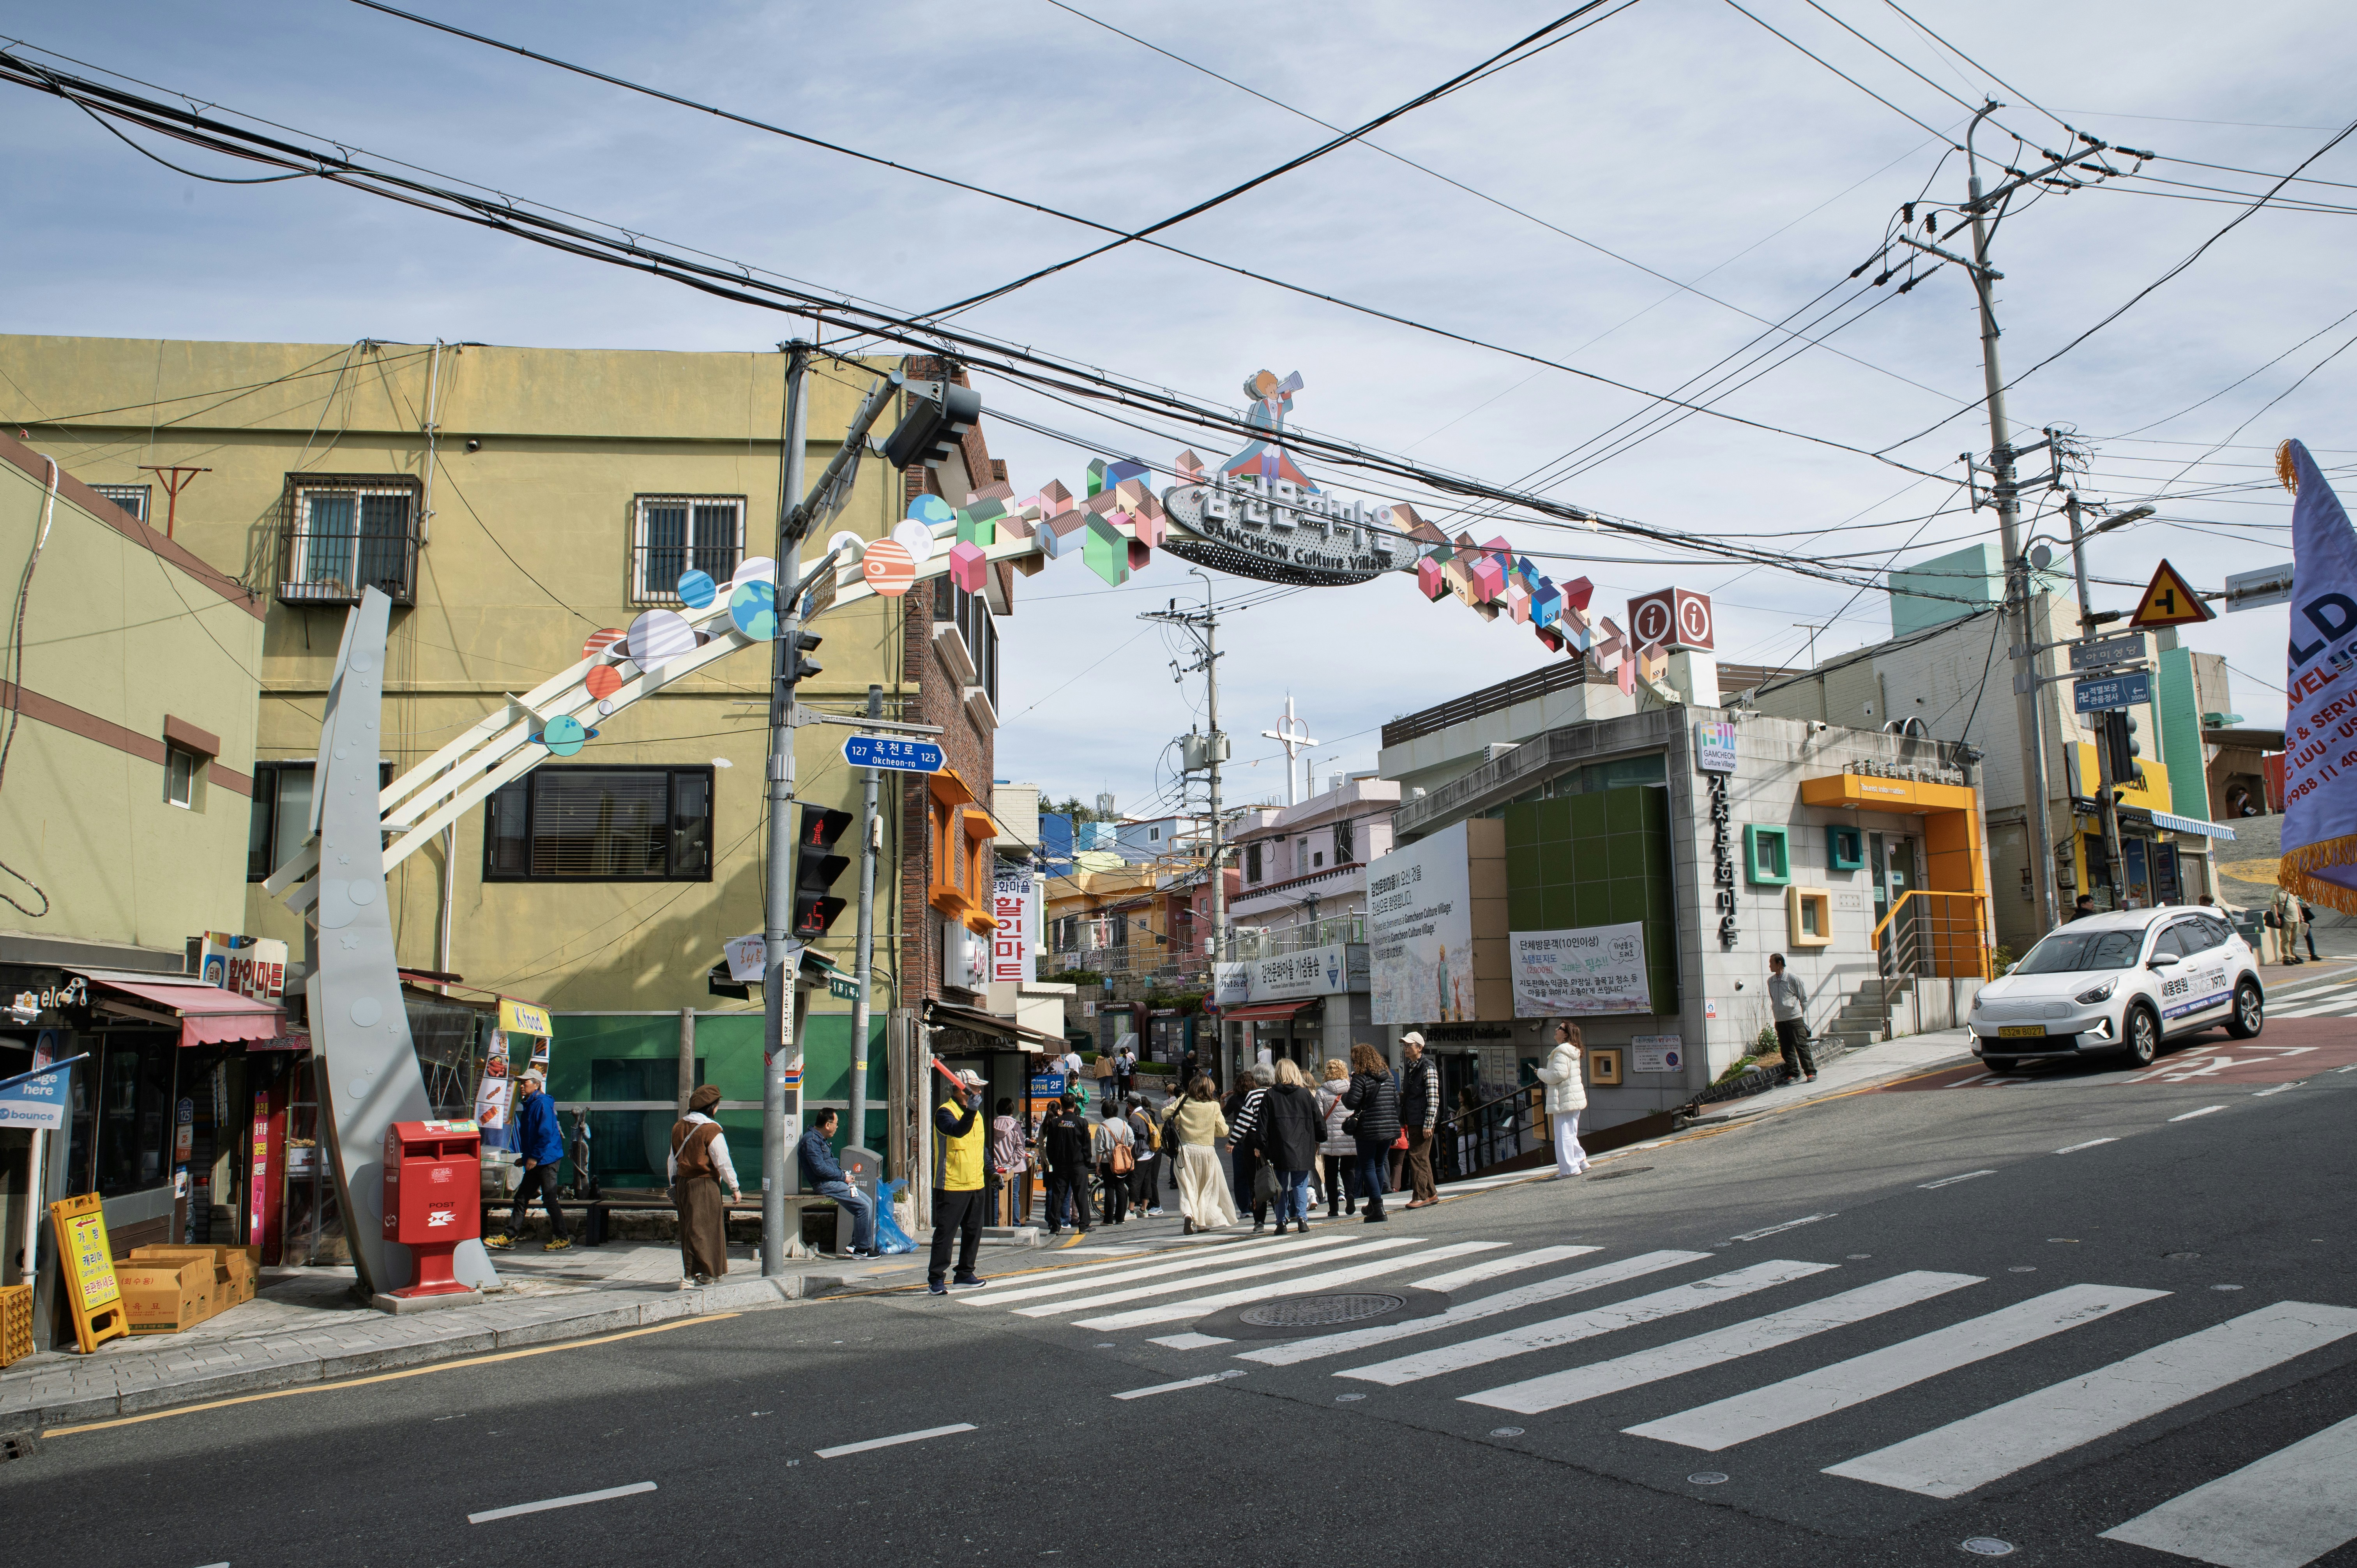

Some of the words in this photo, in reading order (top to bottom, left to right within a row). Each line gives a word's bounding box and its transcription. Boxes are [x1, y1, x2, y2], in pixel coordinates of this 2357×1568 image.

[1196, 470, 1401, 554] 감천문화마을
[1204, 520, 1288, 560] GAMCHEON
[1295, 548, 1344, 569] Culture
[1347, 555, 1392, 571] Village
[2288, 593, 2357, 667] LD
[2086, 645, 2137, 661] 아미성당
[2089, 683, 2118, 695] 적멸보궁
[2090, 693, 2118, 705] 관음정사
[852, 746, 867, 756] 127
[875, 741, 914, 756] 옥천로
[921, 753, 936, 763] 123
[1703, 750, 1735, 759] GAMCHEON
[2294, 740, 2327, 769] LUU
[872, 756, 915, 768] Okcheon-ro
[1721, 760, 1736, 769] Village
[1853, 759, 1921, 782] 감천문화마을
[1922, 768, 1966, 786] 안내센터
[1861, 784, 1877, 793] Tourist
[1878, 785, 1906, 795] Information
[1712, 775, 1741, 945] 감천문화마을
[1371, 872, 1400, 897] 감천문화마을에
[1401, 869, 1410, 886] 오신
[1411, 865, 1422, 881] 것을
[1372, 898, 1388, 916] 진심으로
[1389, 890, 1413, 911] 환영합니다.
[1387, 917, 1402, 929] bienvenus
[1405, 911, 1423, 924] Gamcheon
[1424, 908, 1437, 919] Culture
[995, 897, 1025, 982] 할인마트
[1391, 930, 1408, 942] Gamcheon
[1408, 926, 1422, 938] Culture
[1520, 936, 1599, 950] 단체방문객(10인이상)
[740, 947, 763, 969] 행복
[785, 959, 793, 967] CCTV
[1521, 954, 1557, 964] 스탬프지도
[1561, 963, 1581, 973] 구매는
[1585, 955, 1608, 972] 필수!!
[209, 967, 220, 980] 담배
[1262, 959, 1294, 984] 감천문화마을
[1295, 954, 1320, 978] 기념품숍
[228, 957, 283, 999] 할인마트
[1520, 979, 1569, 987] 지도판매수익금은
[1571, 978, 1592, 986] 화장실,
[1594, 976, 1614, 985] 골목길
[1615, 975, 1629, 984] 청소
[1631, 974, 1638, 983] 등
[2189, 978, 2211, 996] SINCE
[2210, 974, 2226, 990] 1970
[1528, 988, 1546, 997] 마을을
[1549, 987, 1567, 995] 위해서
[1570, 986, 1595, 995] 소중하게
[2161, 977, 2189, 998] 세웅병원
[514, 1006, 525, 1029] K
[523, 1008, 544, 1032] food
[1486, 1027, 1511, 1039] Information
[23, 1084, 54, 1095] here
[1030, 1083, 1048, 1091] 욕카페
[1050, 1081, 1061, 1089] 2F
[11, 1110, 54, 1120] bounce
[180, 1111, 190, 1121] 125
[78, 1227, 99, 1243] 가방
[82, 1250, 104, 1266] 캐리어
[82, 1268, 95, 1277] Carrier
[85, 1275, 115, 1295] 보관하세요
